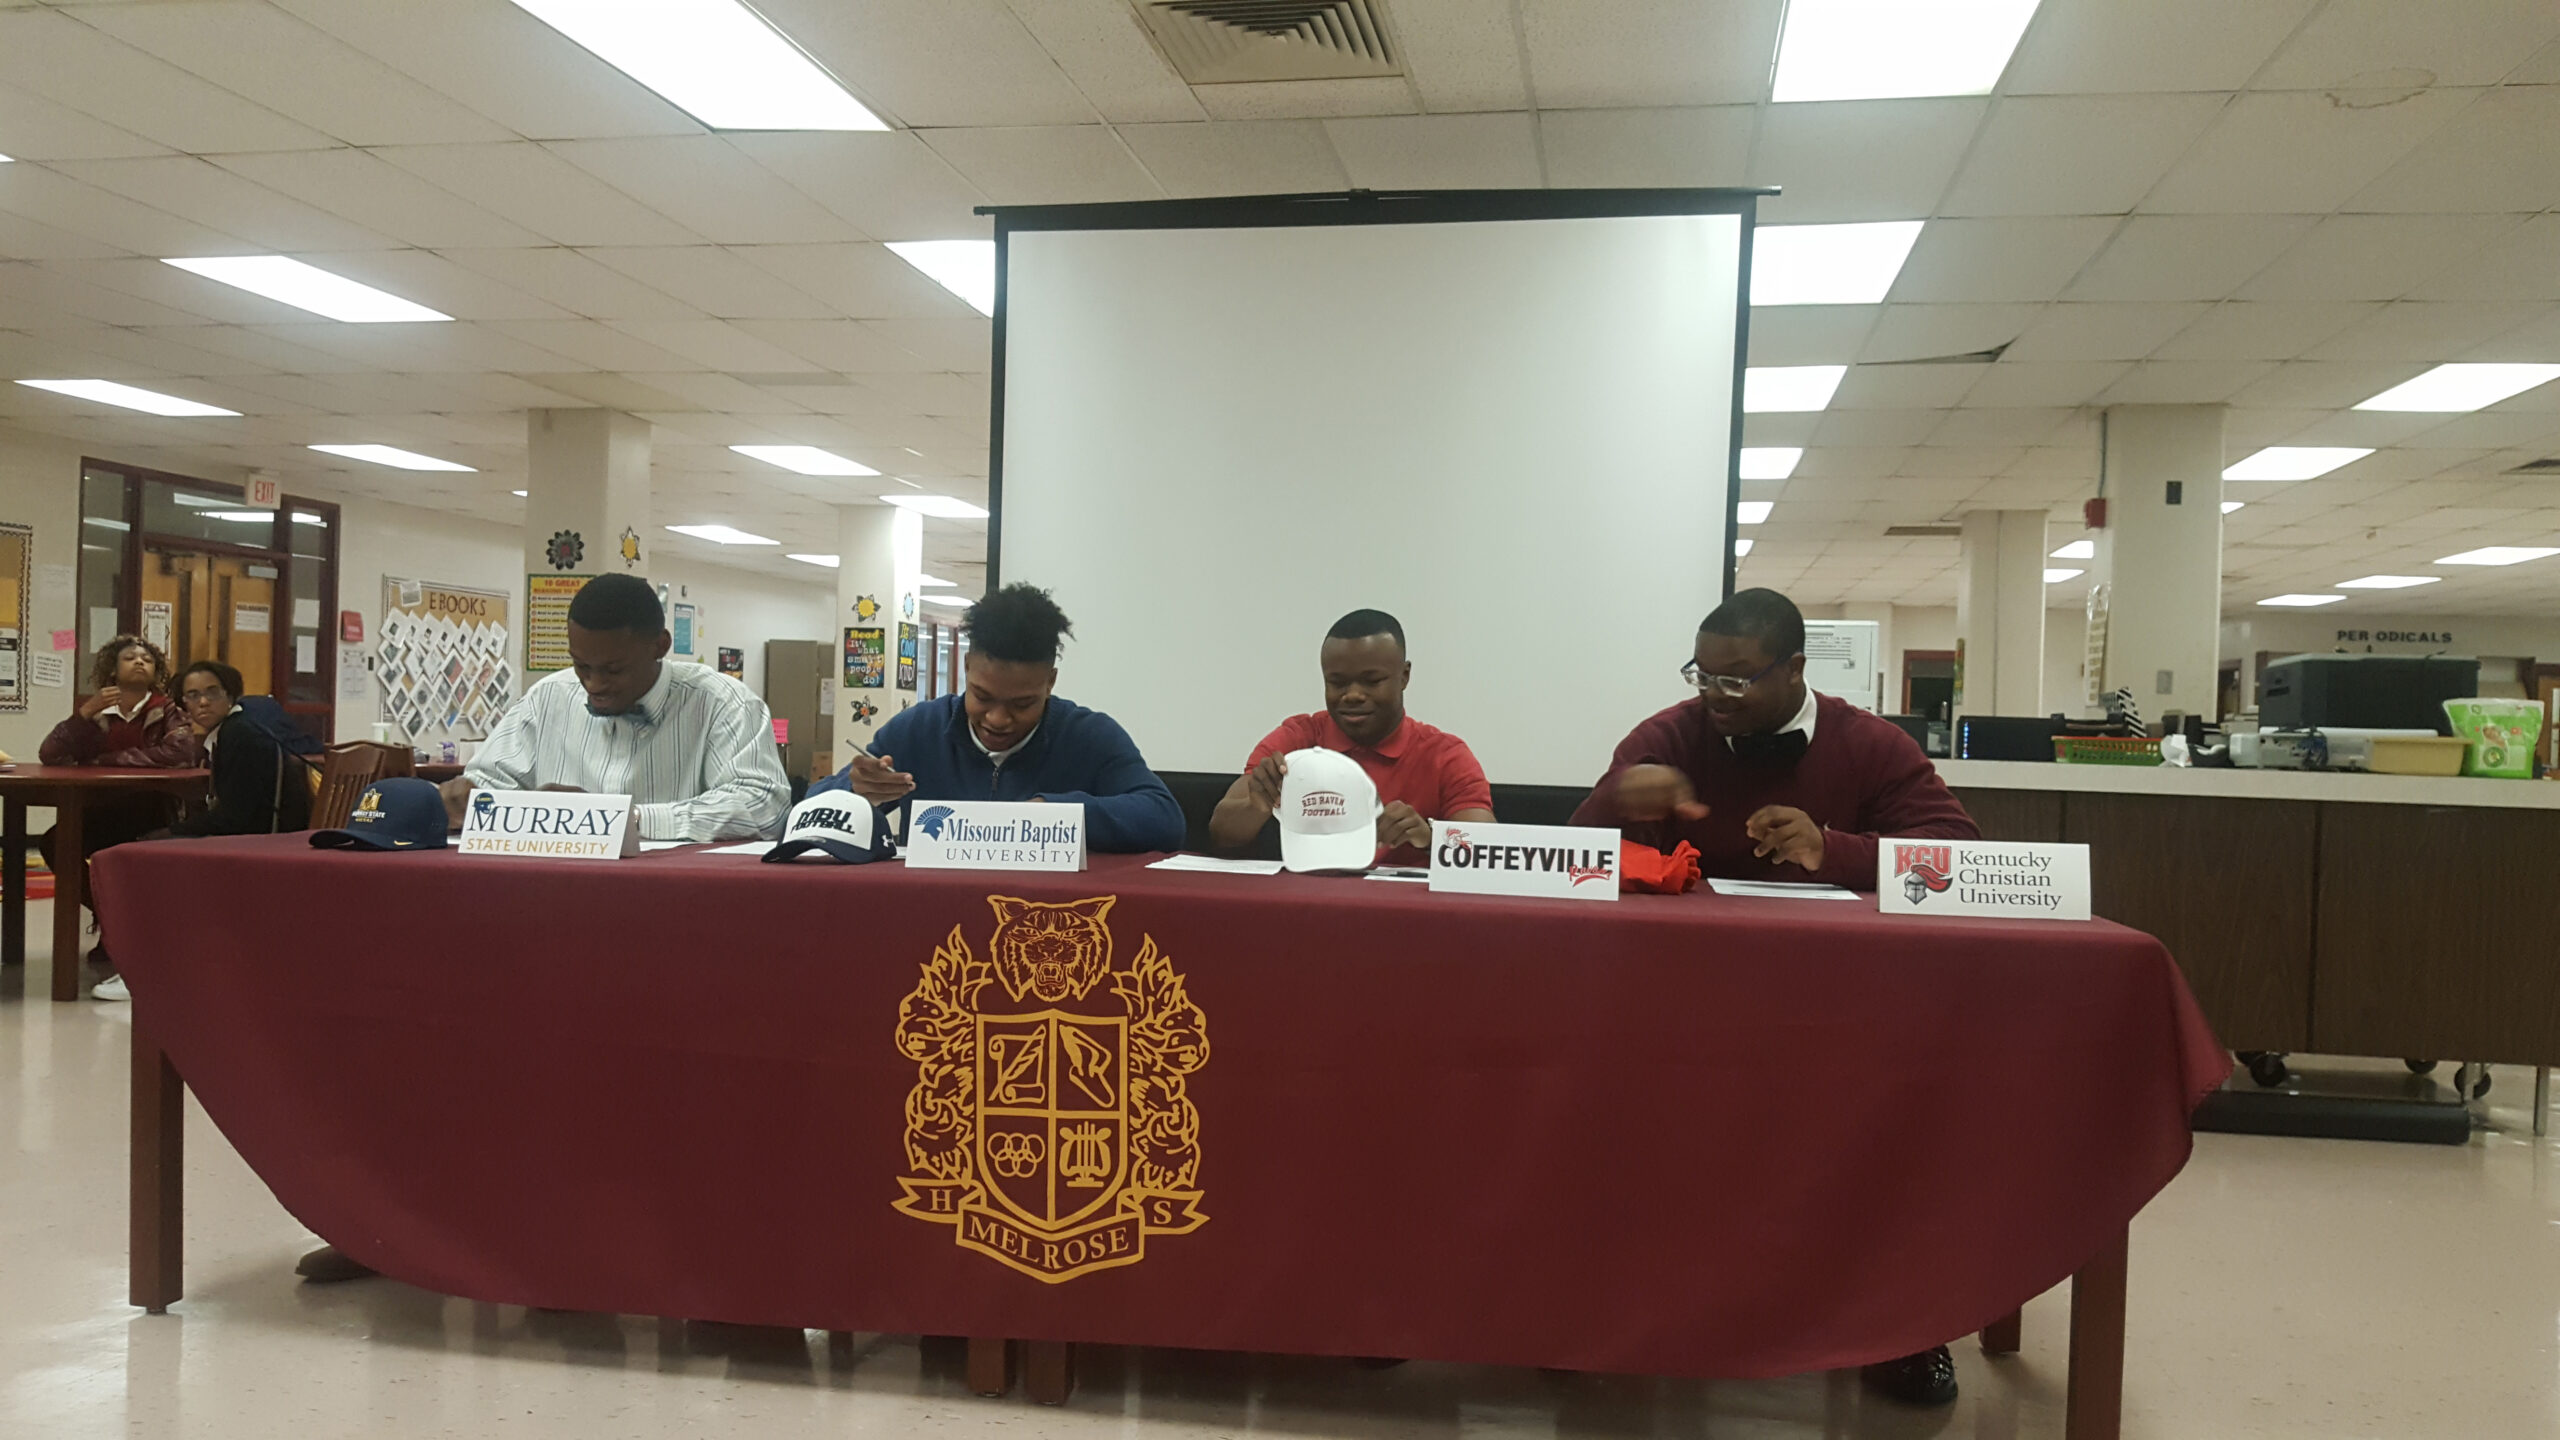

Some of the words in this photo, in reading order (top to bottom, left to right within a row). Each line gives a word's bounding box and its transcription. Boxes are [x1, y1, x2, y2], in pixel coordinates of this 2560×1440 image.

[255, 480, 275, 503] EXIT
[429, 592, 487, 616] EBOOKS
[850, 629, 880, 639] Read
[850, 640, 867, 648] It's
[847, 655, 882, 663] smart
[850, 665, 882, 674] people
[1301, 796, 1317, 807] RED
[1319, 796, 1345, 806] RAVEN
[467, 806, 625, 836] MURRAY
[798, 807, 852, 823] MBU
[1302, 808, 1346, 817] FOOTBALL
[946, 818, 1016, 842] Missouri
[1020, 819, 1077, 850] Baptist
[467, 838, 512, 851] STATE
[516, 840, 609, 855] UNIVERSITY
[946, 848, 1075, 863] UNIVERSITY
[1438, 843, 1613, 873] COFFEYVILLE
[1894, 844, 1952, 877] KCU
[1959, 850, 2052, 871] Kentucky
[1959, 869, 2051, 887] Christian
[1960, 888, 2062, 911] University
[930, 1188, 953, 1213] H
[1152, 1200, 1173, 1225] S
[968, 1215, 1130, 1271] MELROSE
